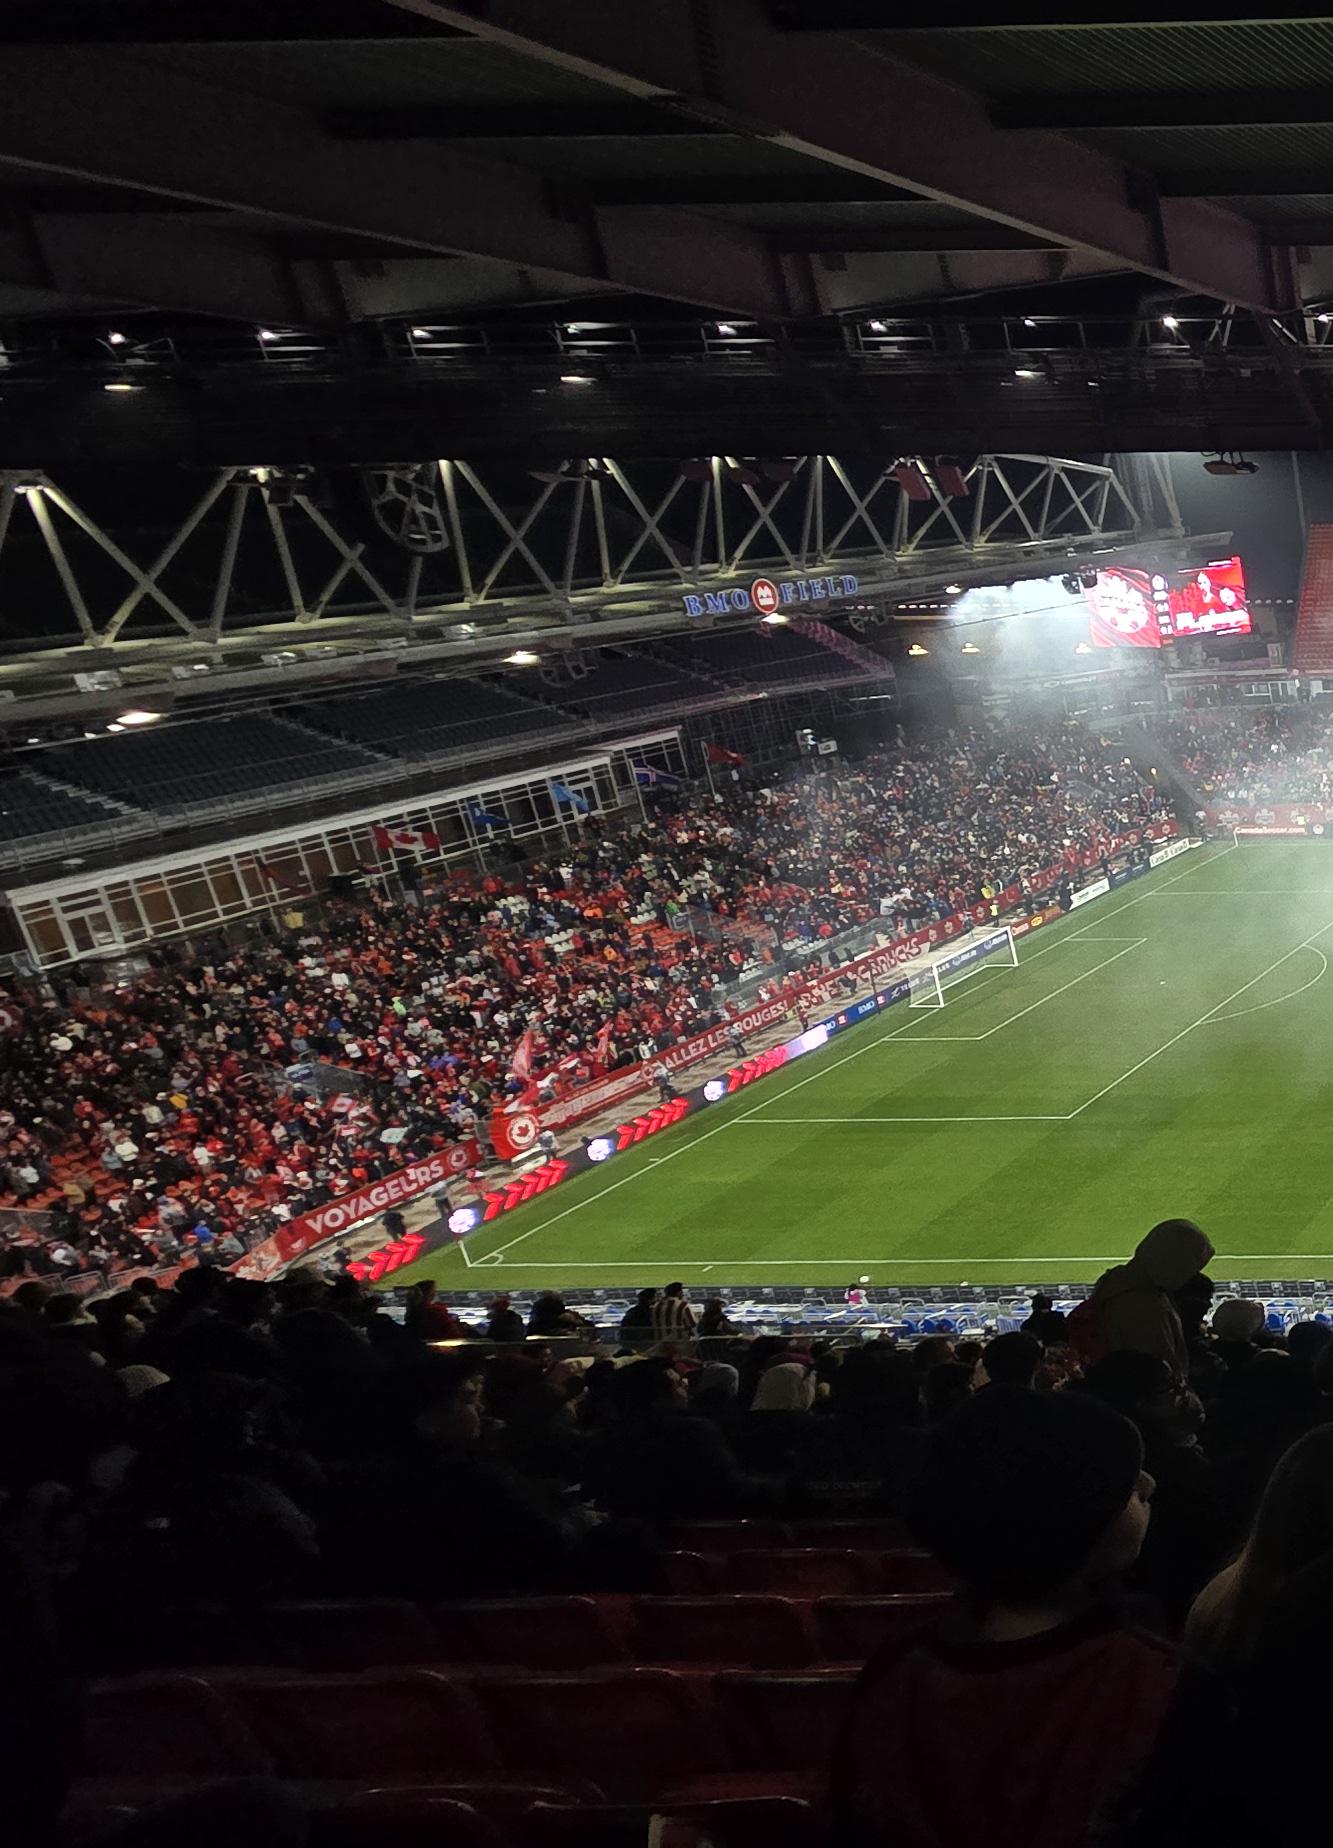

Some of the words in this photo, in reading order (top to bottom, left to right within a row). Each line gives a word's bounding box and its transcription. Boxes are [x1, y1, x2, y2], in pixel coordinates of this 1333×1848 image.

[682, 588, 749, 617] BMO
[780, 574, 858, 604] FIELD
[858, 1000, 875, 1015] BMO
[665, 1036, 707, 1069] ALLEZ
[707, 1027, 731, 1048] LES
